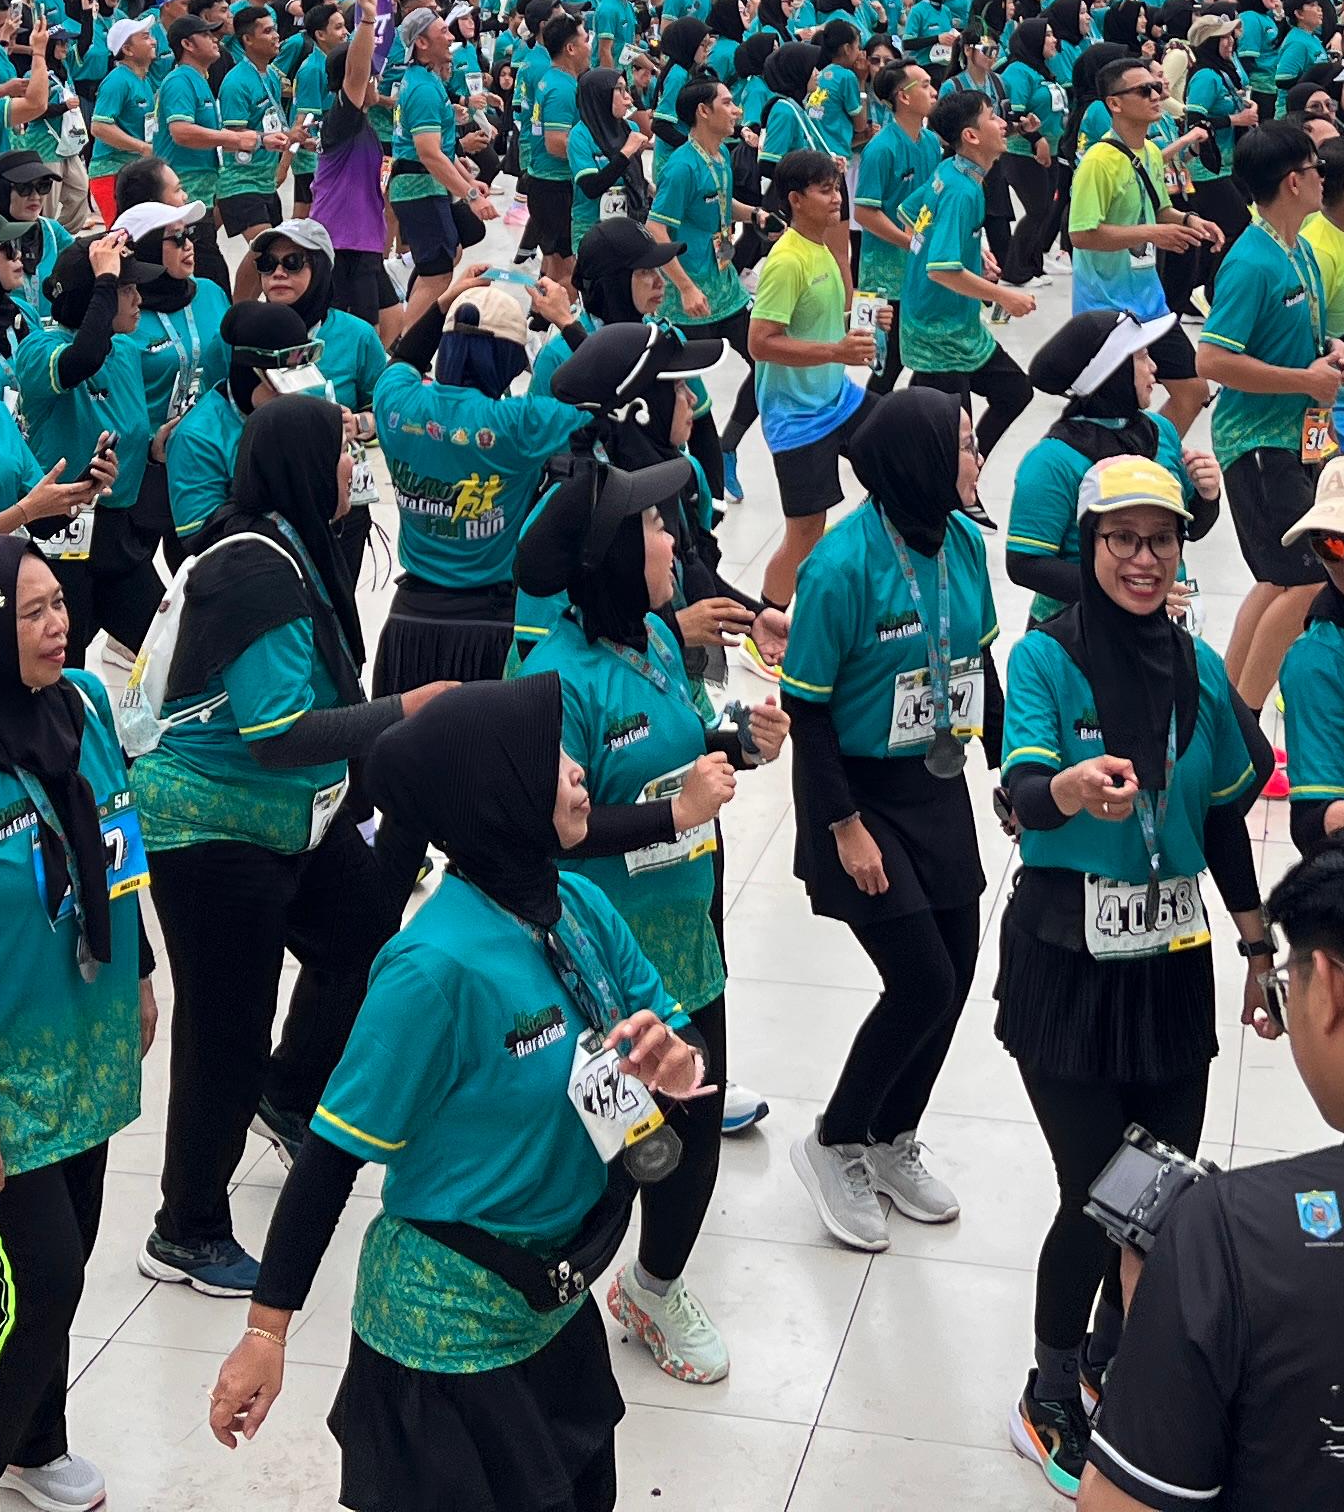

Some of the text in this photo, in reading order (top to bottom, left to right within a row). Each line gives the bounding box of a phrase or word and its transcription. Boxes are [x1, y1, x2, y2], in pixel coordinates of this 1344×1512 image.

[419, 497, 453, 518] Cinta
[465, 516, 505, 541] Run
[896, 680, 974, 730] 457
[12, 811, 38, 833] Cinta
[1096, 880, 1196, 937] 4068
[515, 1022, 567, 1058] Bara Cinta
